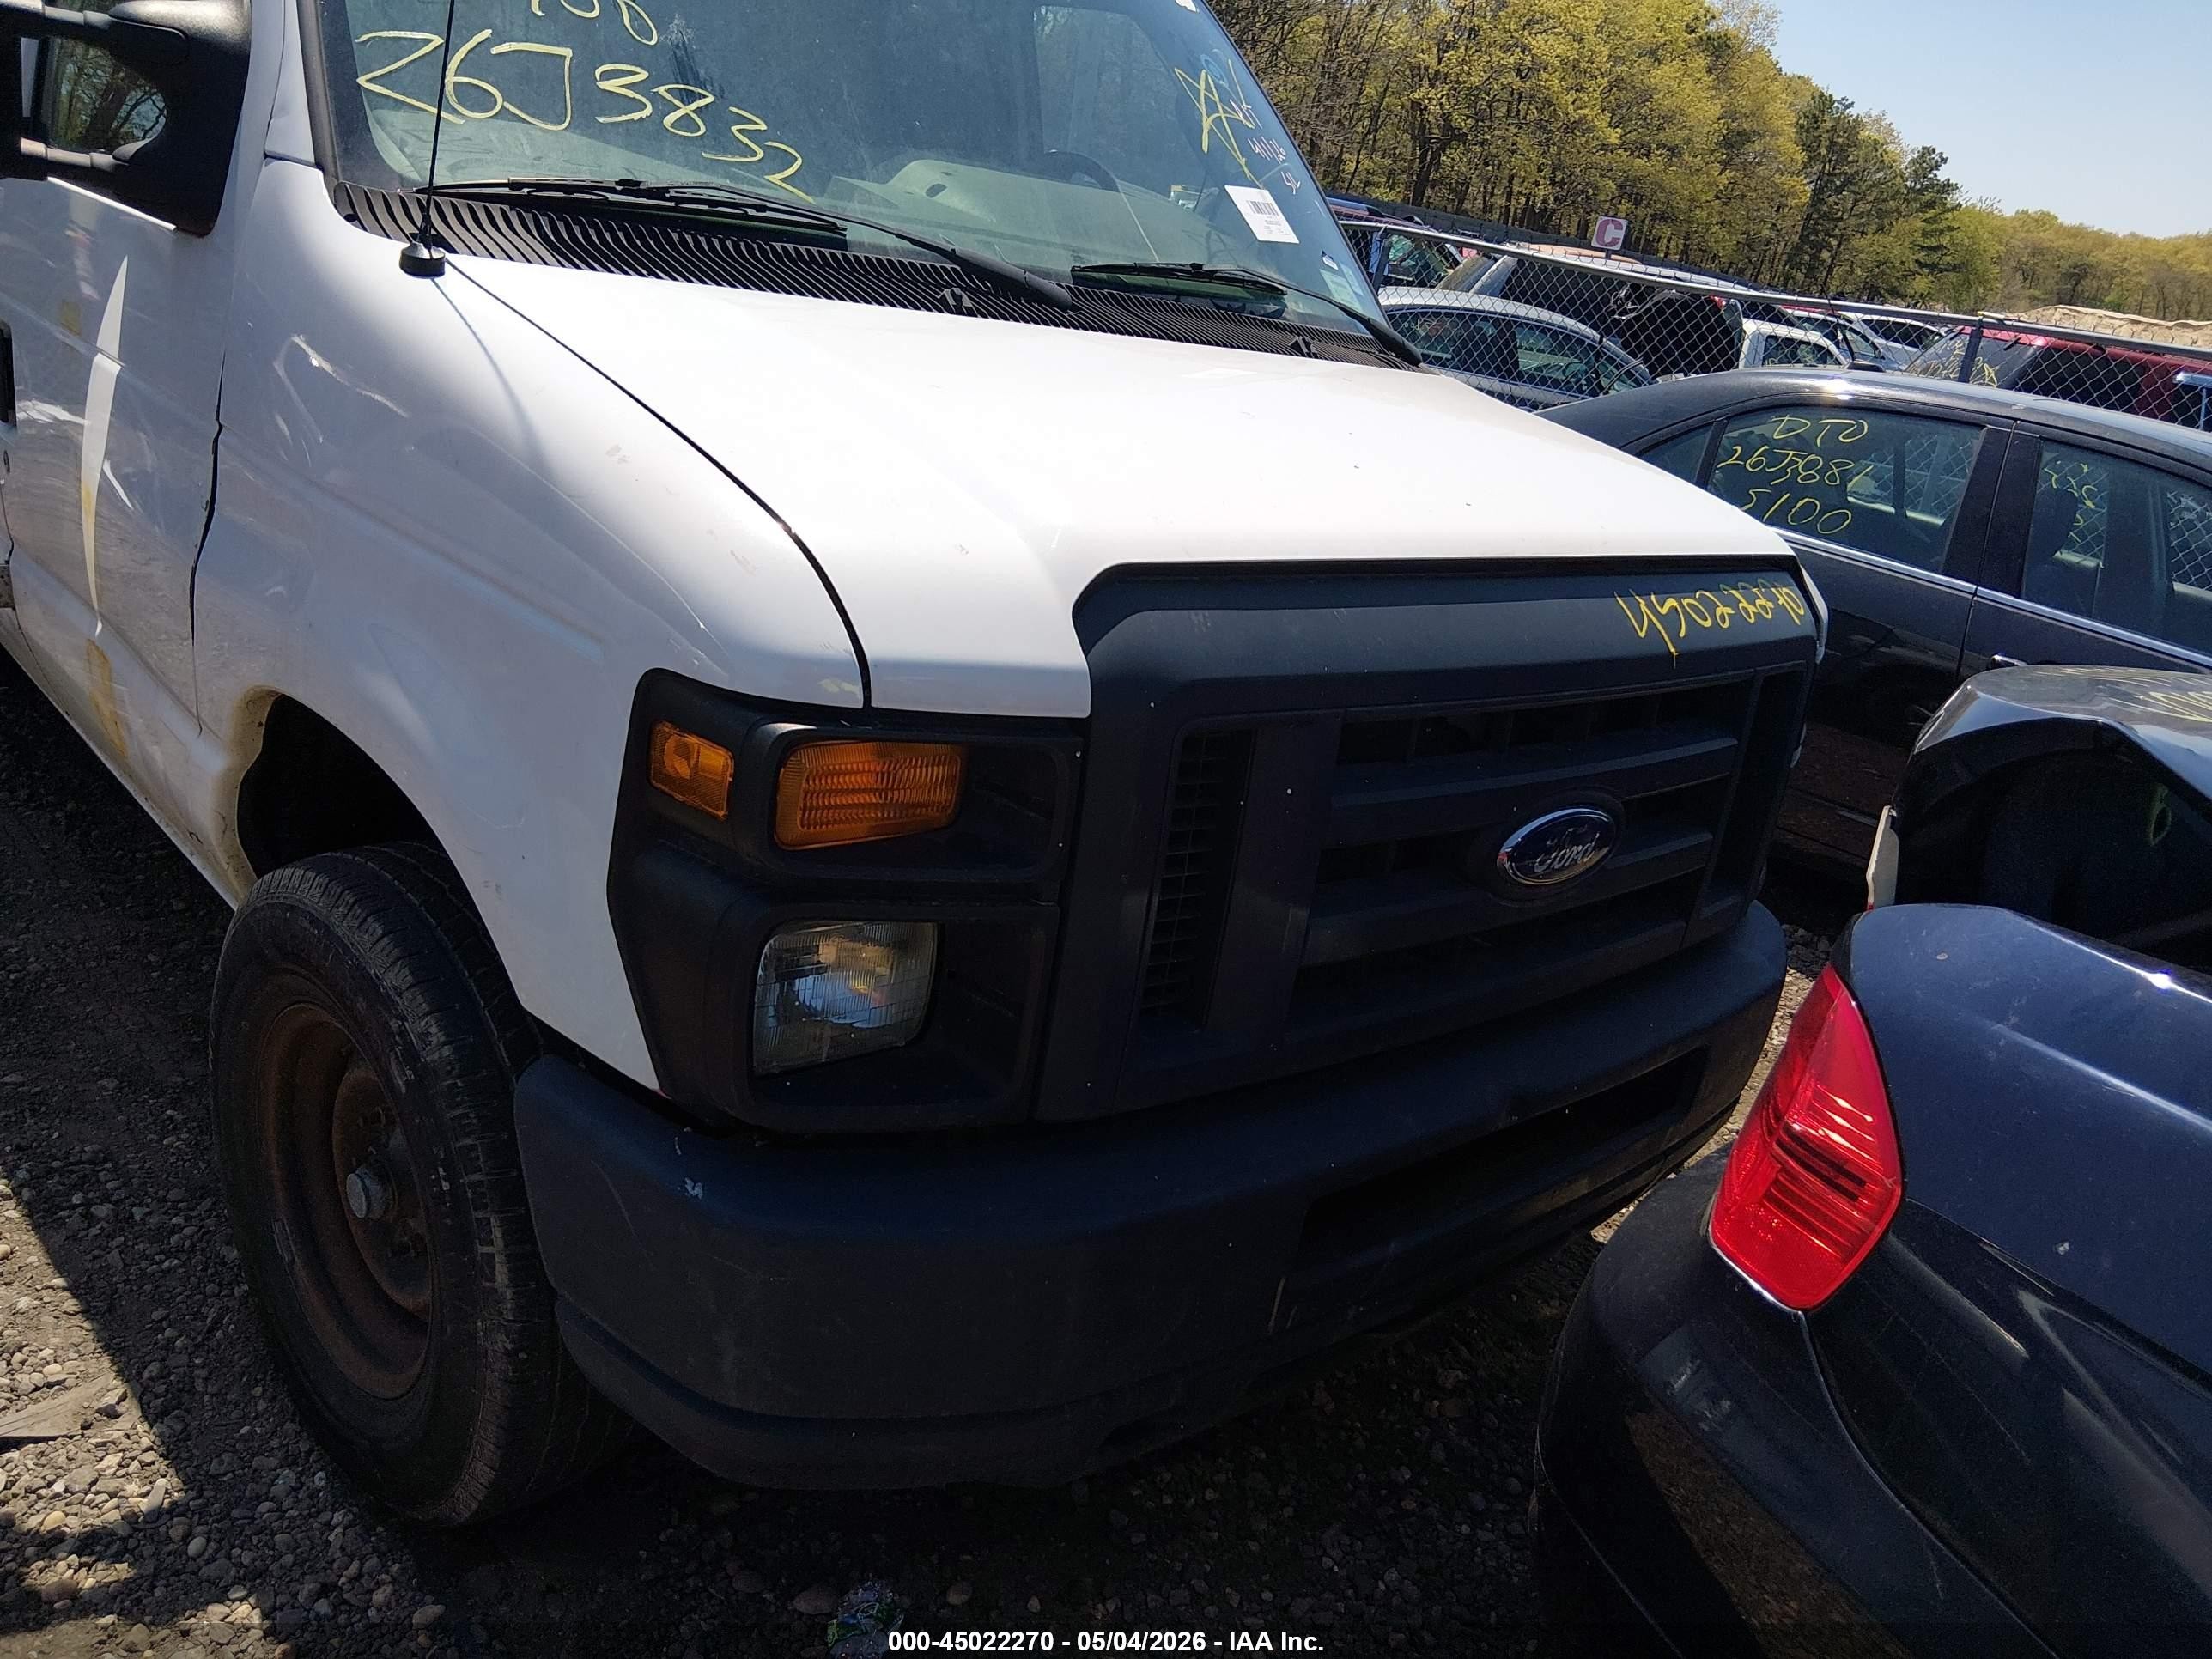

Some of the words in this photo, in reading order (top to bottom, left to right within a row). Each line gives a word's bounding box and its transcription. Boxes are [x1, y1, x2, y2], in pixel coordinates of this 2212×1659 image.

[1595, 218, 1624, 247] C
[1741, 488, 1852, 534] 5100
[1533, 824, 1601, 874] Ford
